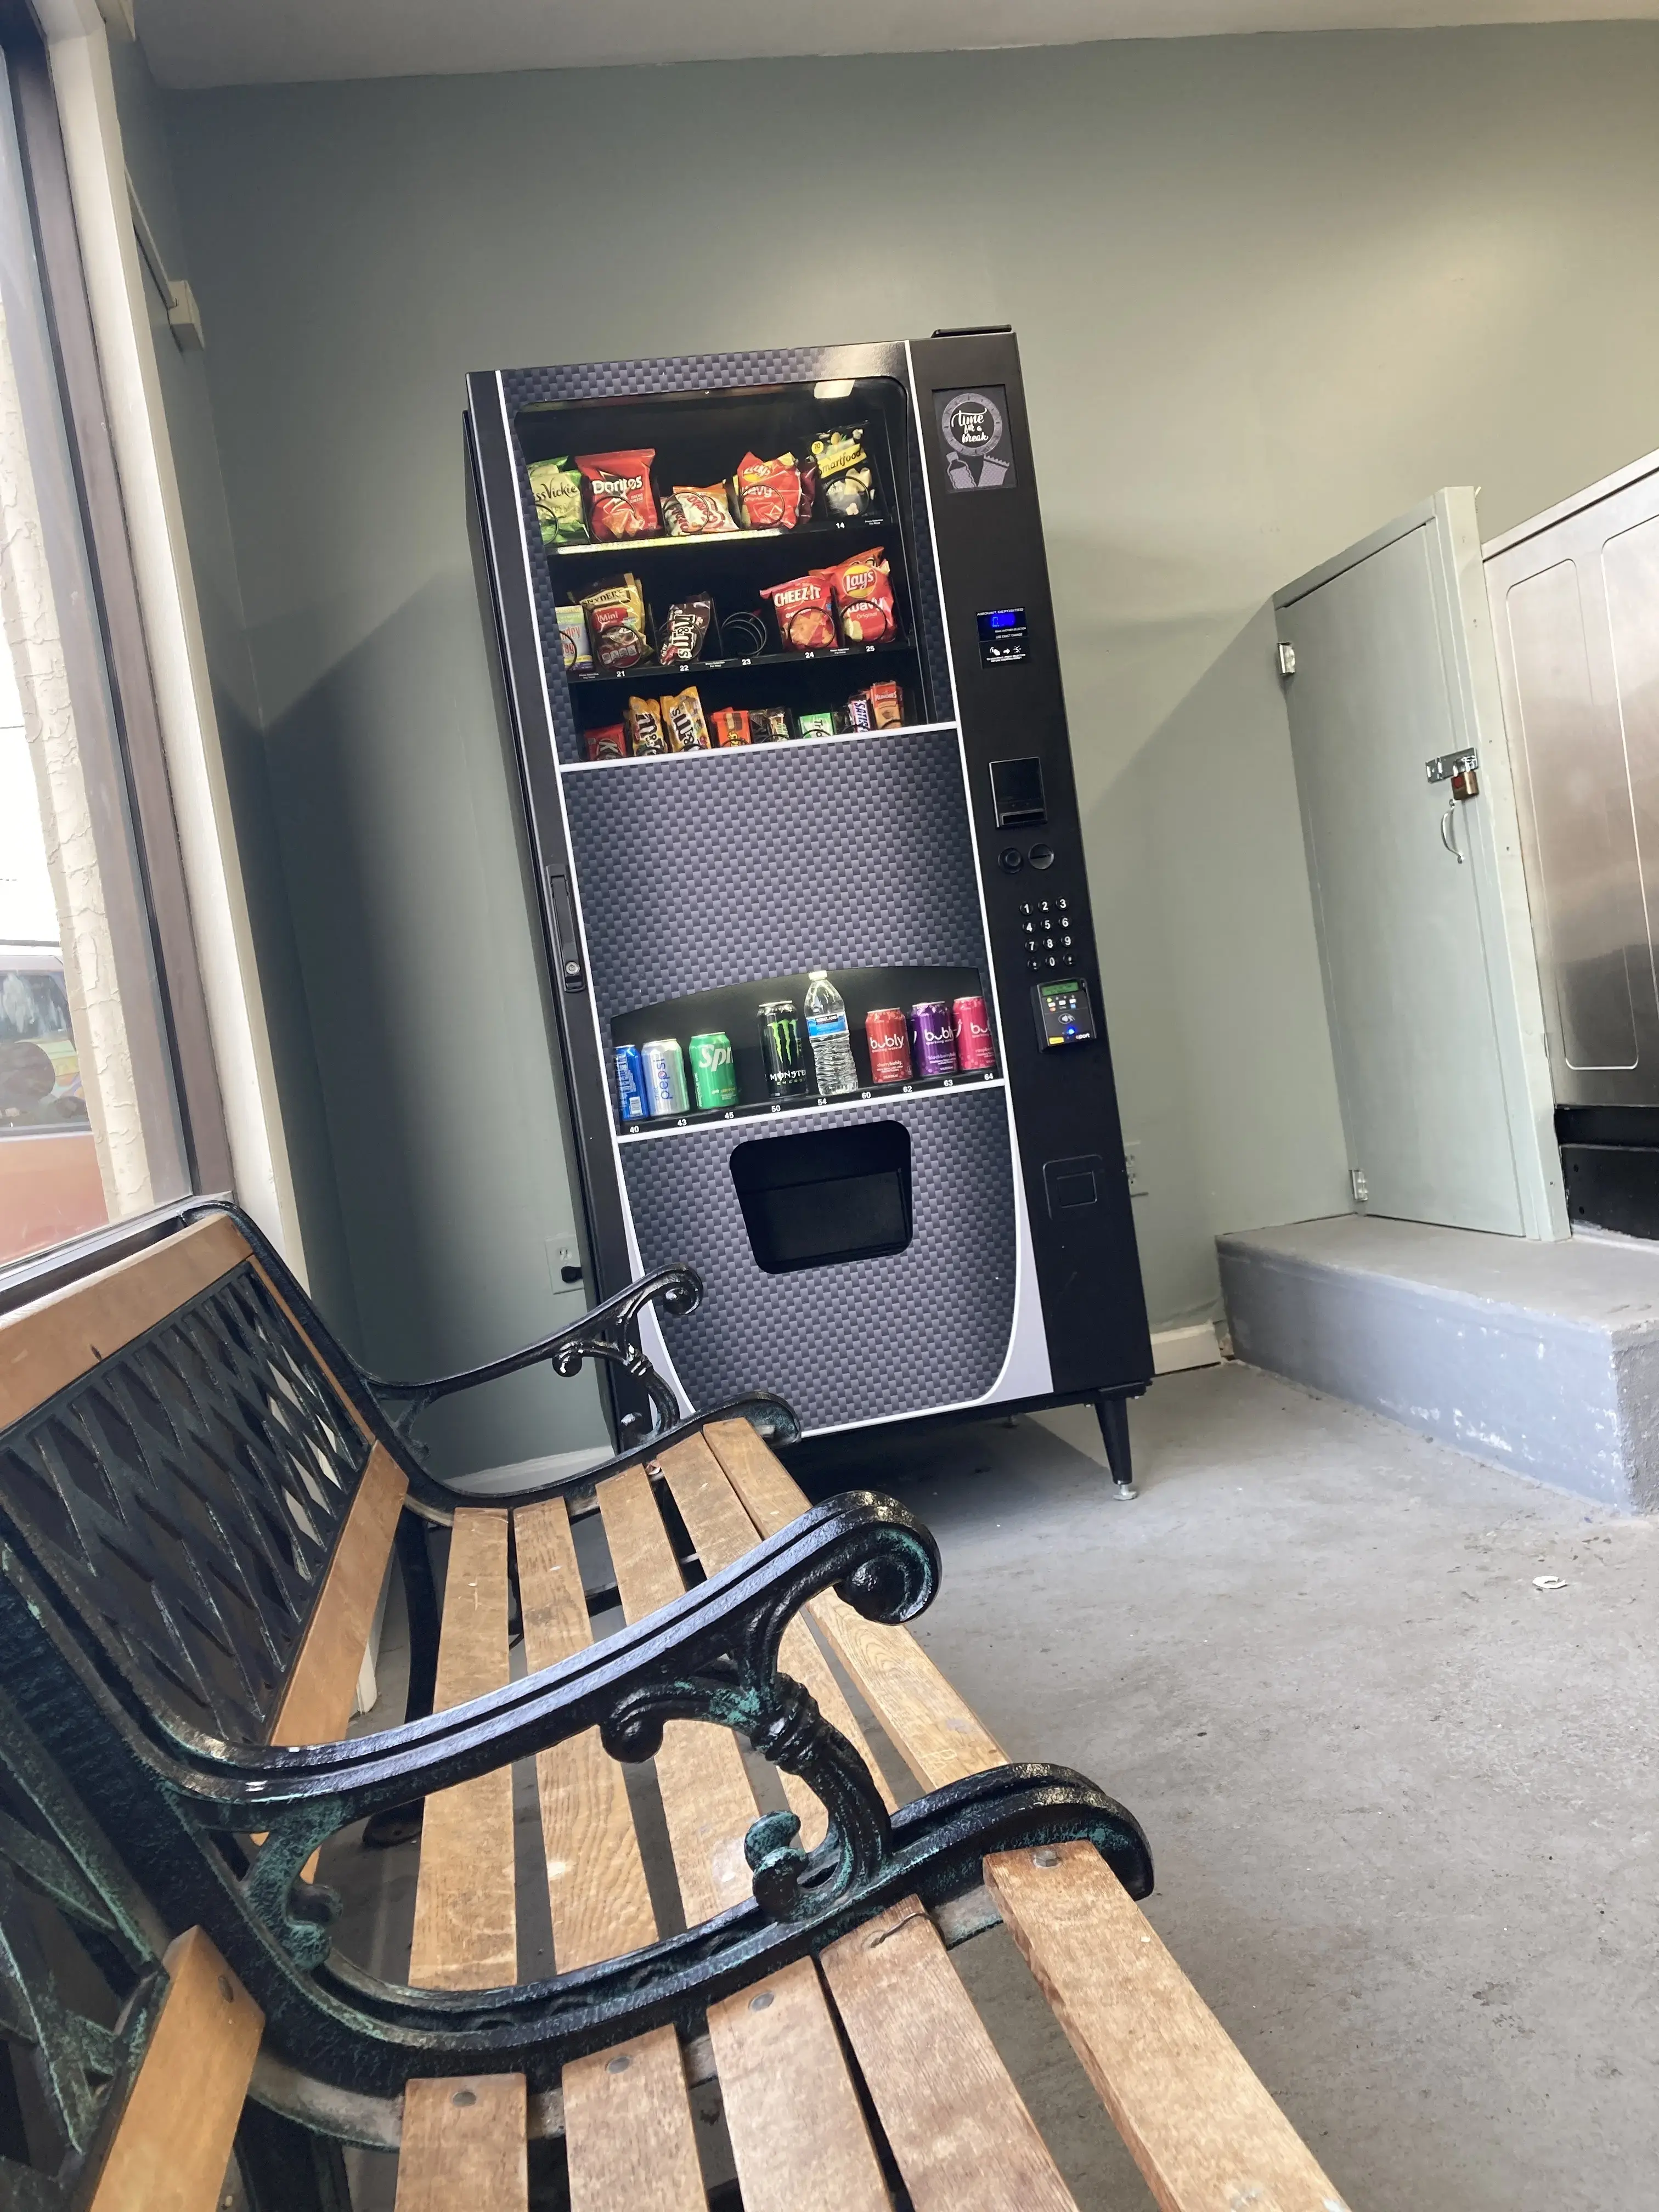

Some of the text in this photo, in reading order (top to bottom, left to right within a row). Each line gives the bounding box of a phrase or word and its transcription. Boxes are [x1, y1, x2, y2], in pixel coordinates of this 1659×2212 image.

[962, 432, 989, 443] break
[821, 449, 861, 473] martfood
[592, 476, 642, 494] Doritos
[599, 611, 619, 622] Mini
[1024, 899, 1066, 913] 1 2 3
[1026, 917, 1069, 932] 4 5 6
[1029, 936, 1071, 951] 7 8 9
[1049, 957, 1056, 967] 0
[870, 1034, 904, 1049] bubly
[653, 1058, 674, 1099] pepsi
